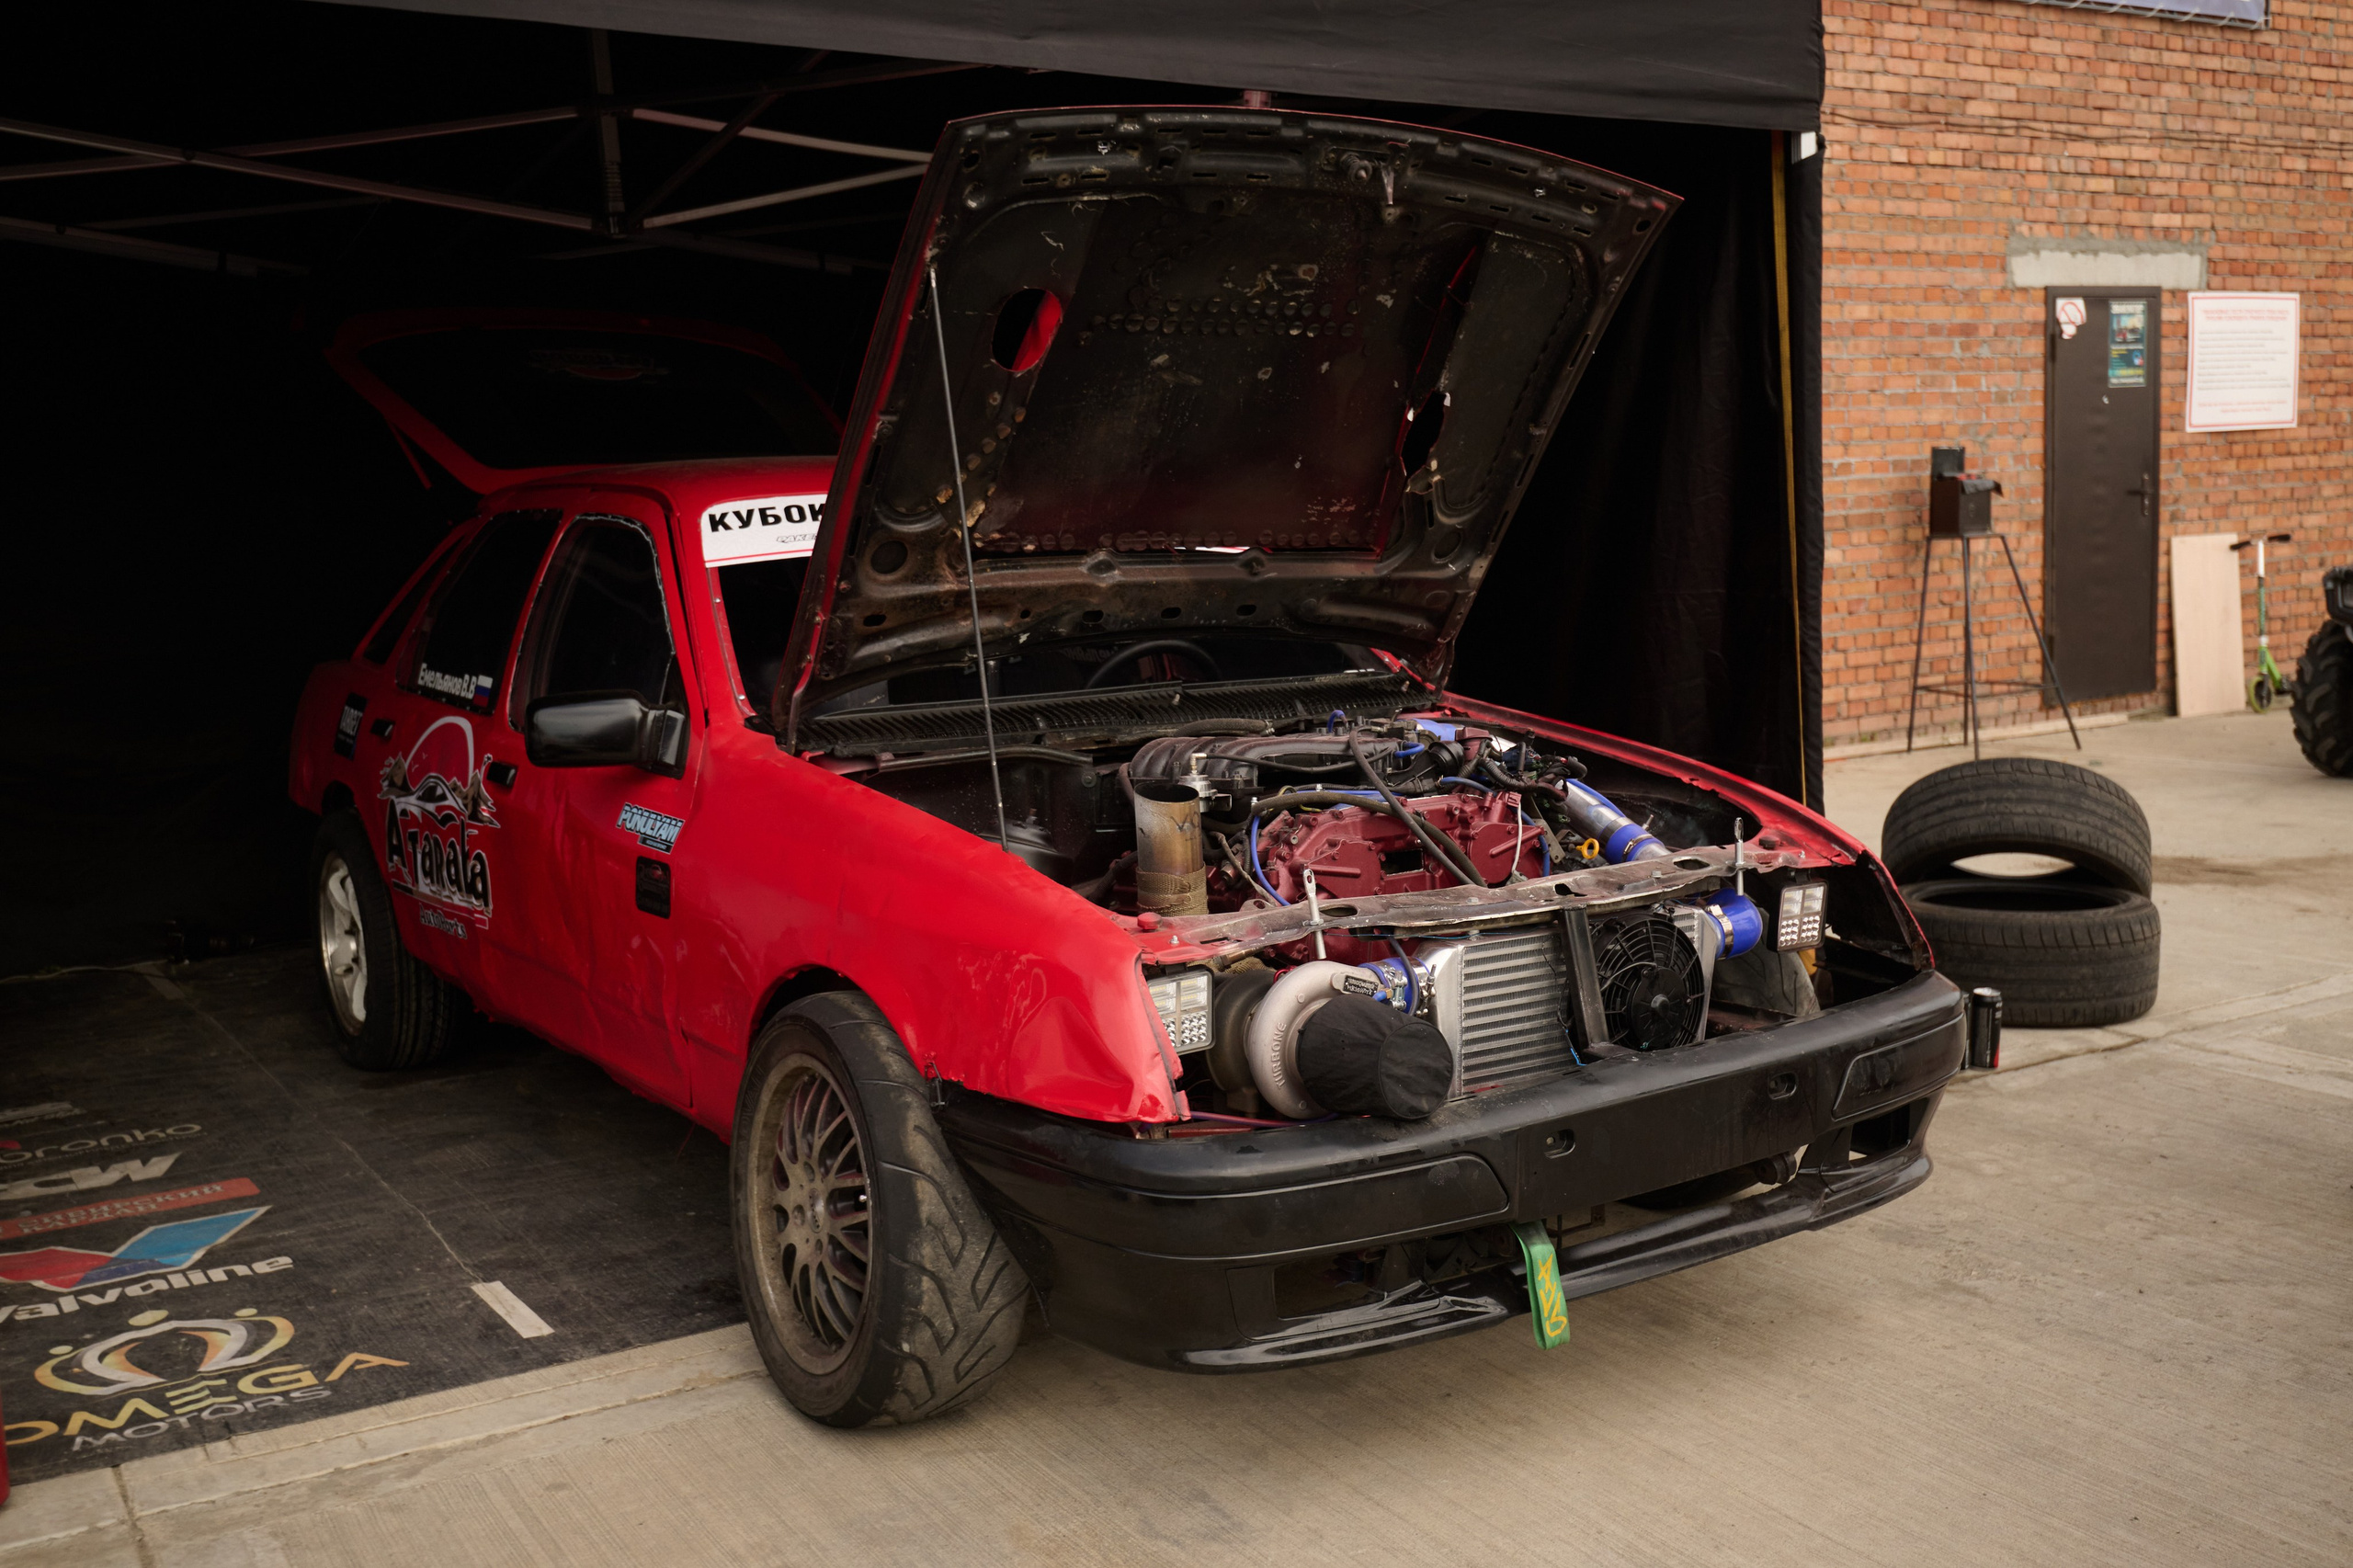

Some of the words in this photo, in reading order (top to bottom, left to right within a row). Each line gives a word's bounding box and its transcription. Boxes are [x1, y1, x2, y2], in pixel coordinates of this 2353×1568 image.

[776, 533, 817, 544] РАКЕ
[616, 802, 686, 845] PONULYAM
[72, 1385, 332, 1453] MOTORS
